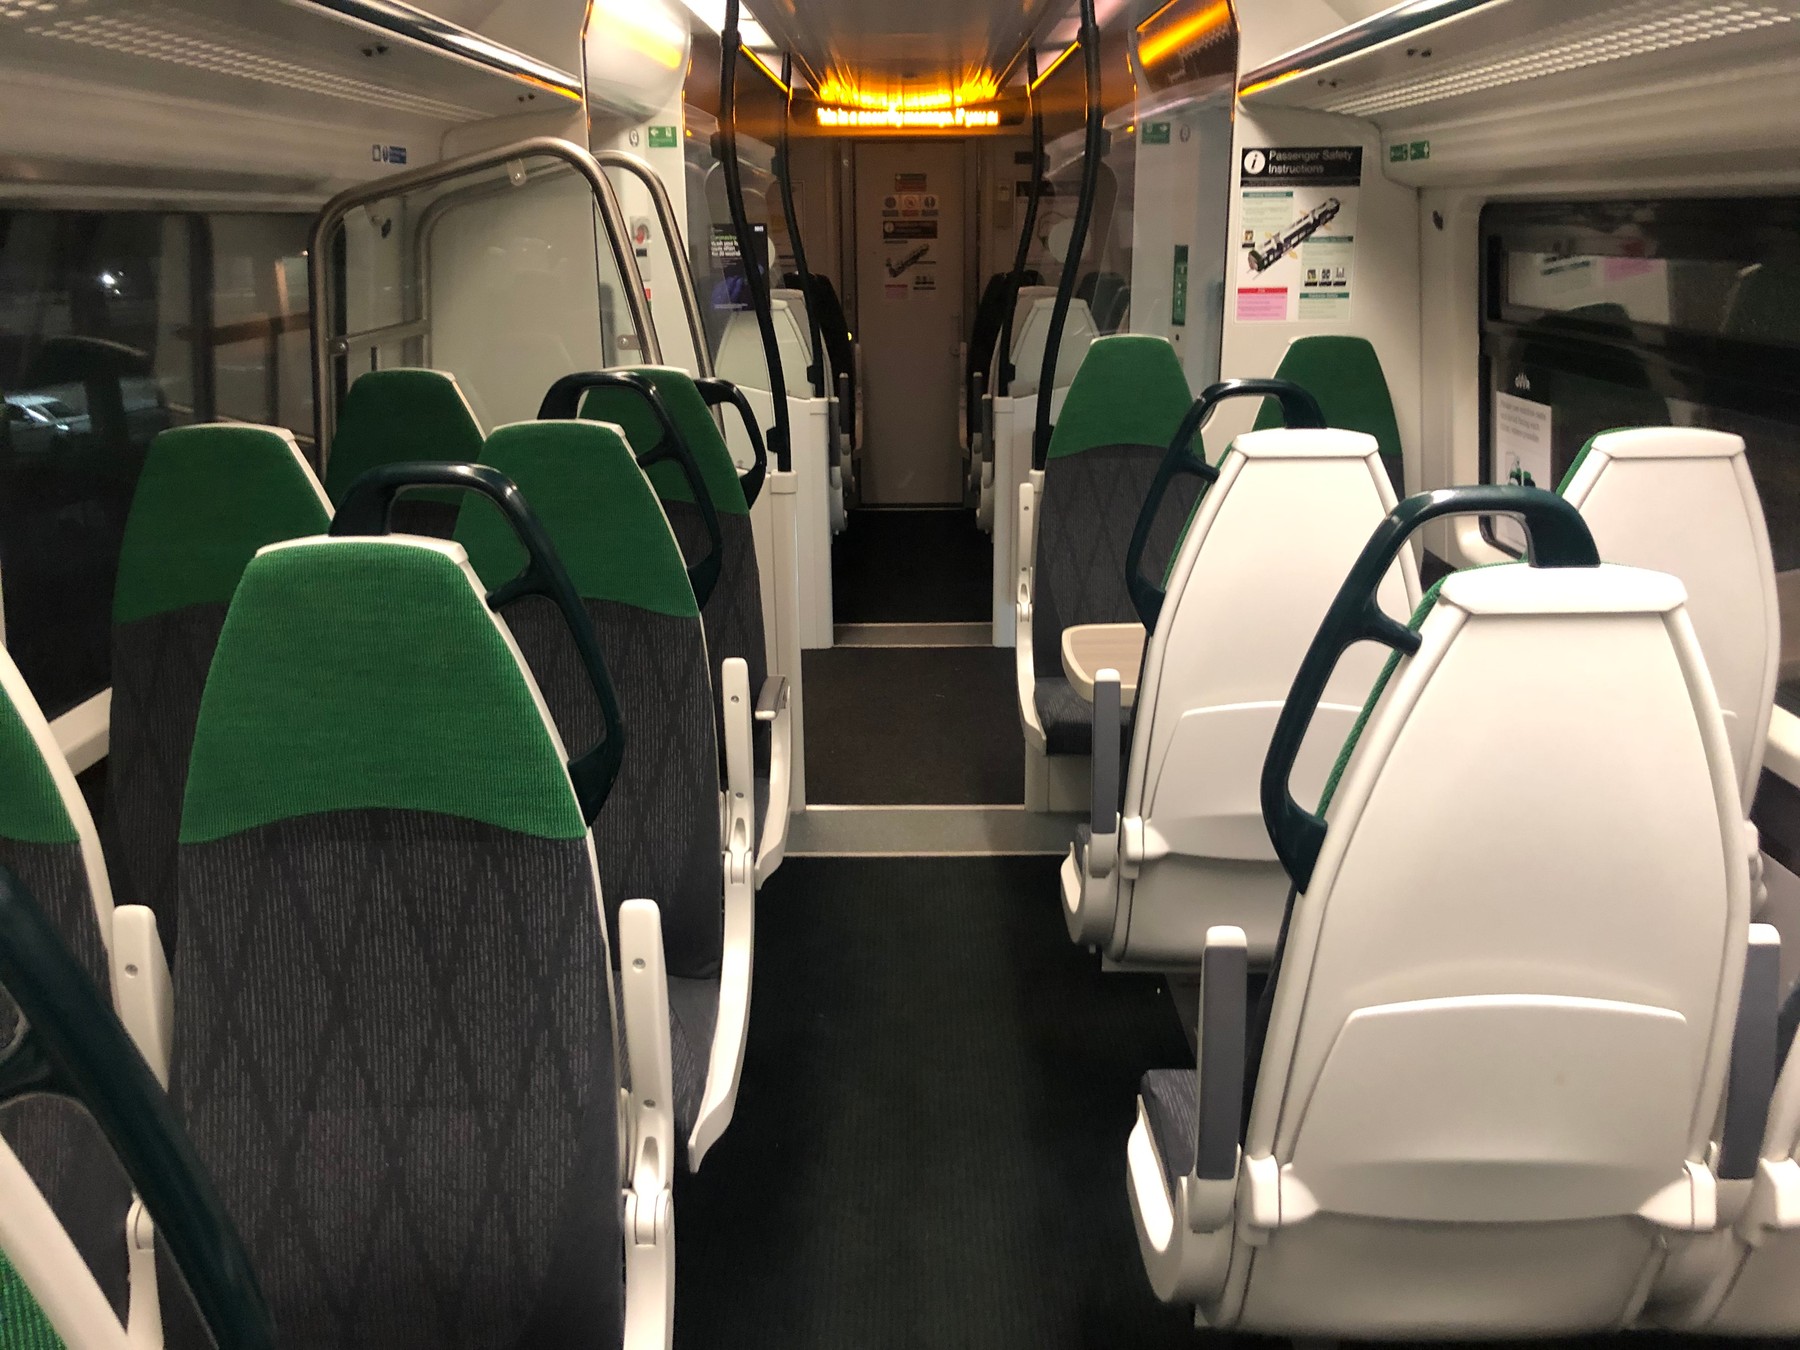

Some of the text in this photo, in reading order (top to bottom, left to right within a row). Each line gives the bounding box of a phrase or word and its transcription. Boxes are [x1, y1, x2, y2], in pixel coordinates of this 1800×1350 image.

[1269, 149, 1320, 162] Passenger
[1322, 149, 1354, 162] Safety
[1268, 163, 1325, 174] Instructions
